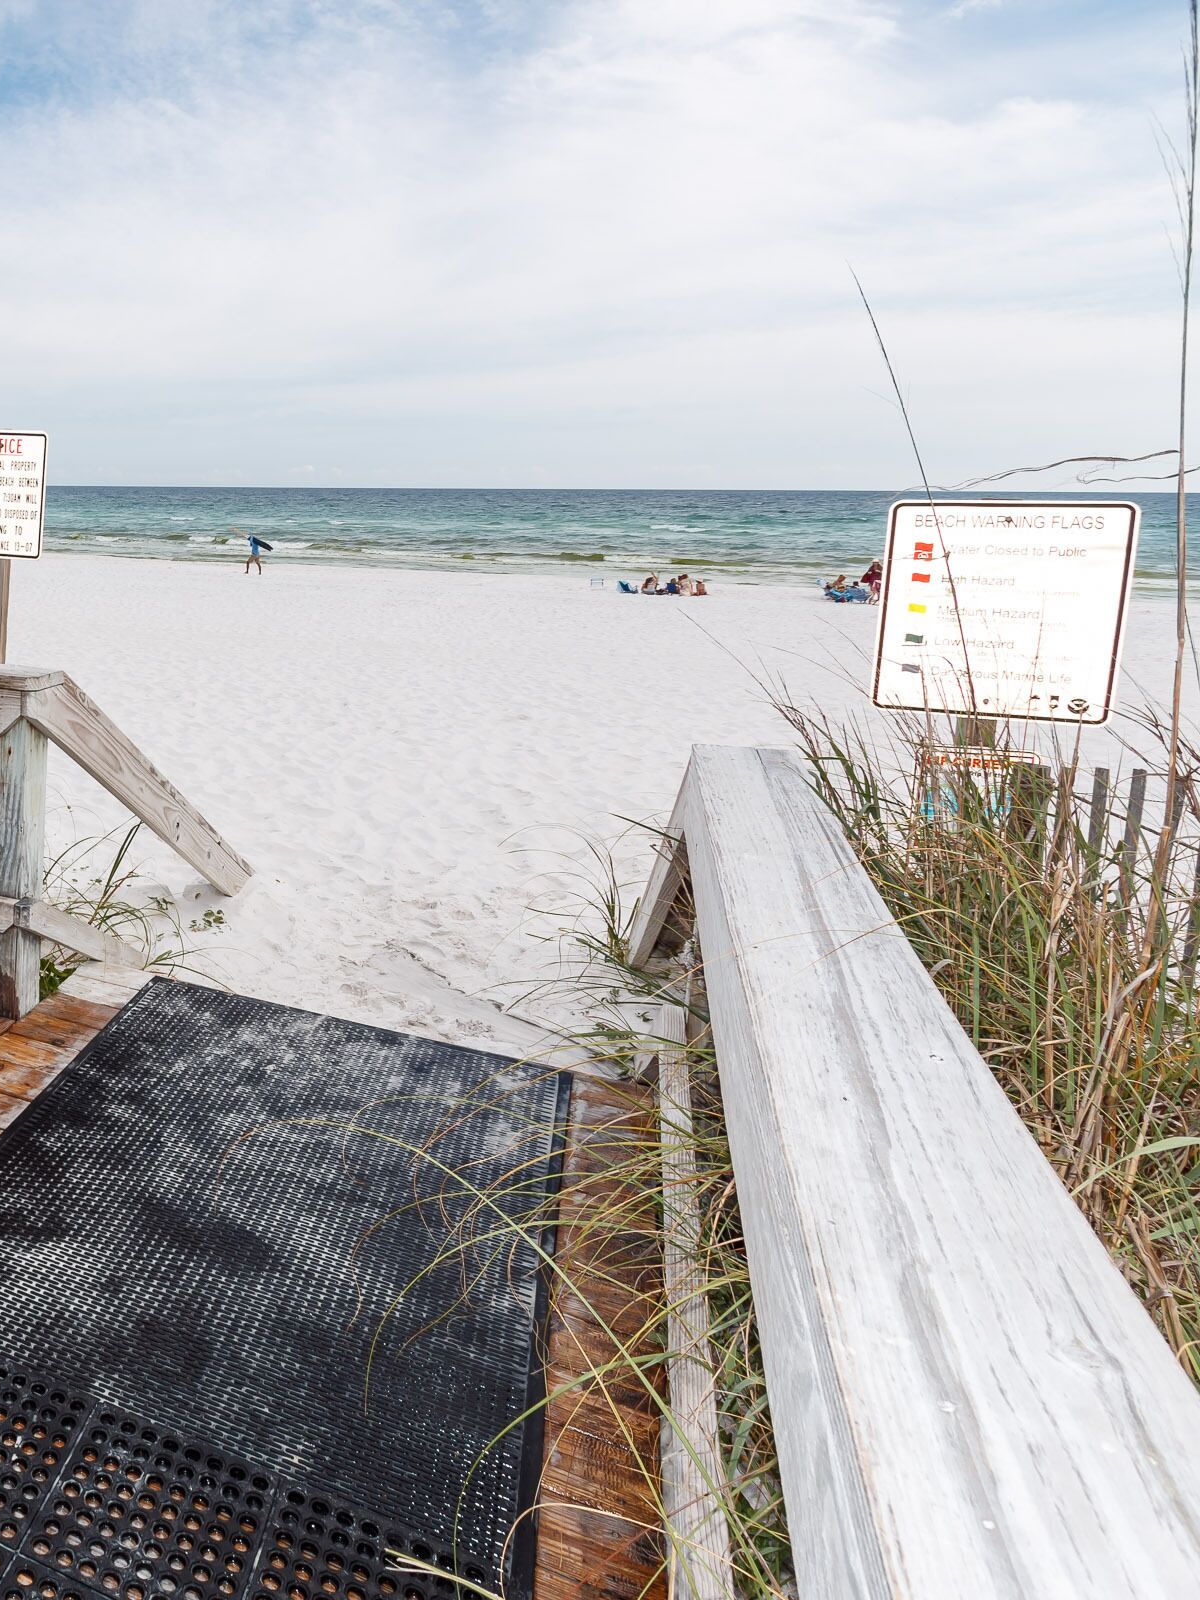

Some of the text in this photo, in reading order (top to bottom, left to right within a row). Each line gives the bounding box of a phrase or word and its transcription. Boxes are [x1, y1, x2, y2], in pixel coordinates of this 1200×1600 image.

[10, 460, 37, 471] PROPERTY
[0, 476, 14, 487] BEACH
[18, 477, 39, 488] BETWEEN
[25, 494, 37, 504] WILL
[4, 509, 29, 520] DISPOSED
[29, 510, 38, 520] OF
[914, 514, 1105, 530] BEACH WARNING FLAGS
[14, 525, 23, 536] TO
[985, 544, 1028, 557] Closed
[1032, 545, 1044, 557] to
[1049, 546, 1088, 558] Public
[971, 574, 1016, 587] Hazard
[992, 608, 1040, 620] Hazard
[934, 636, 1015, 650] Low Hazard
[1049, 671, 1073, 685] Life
